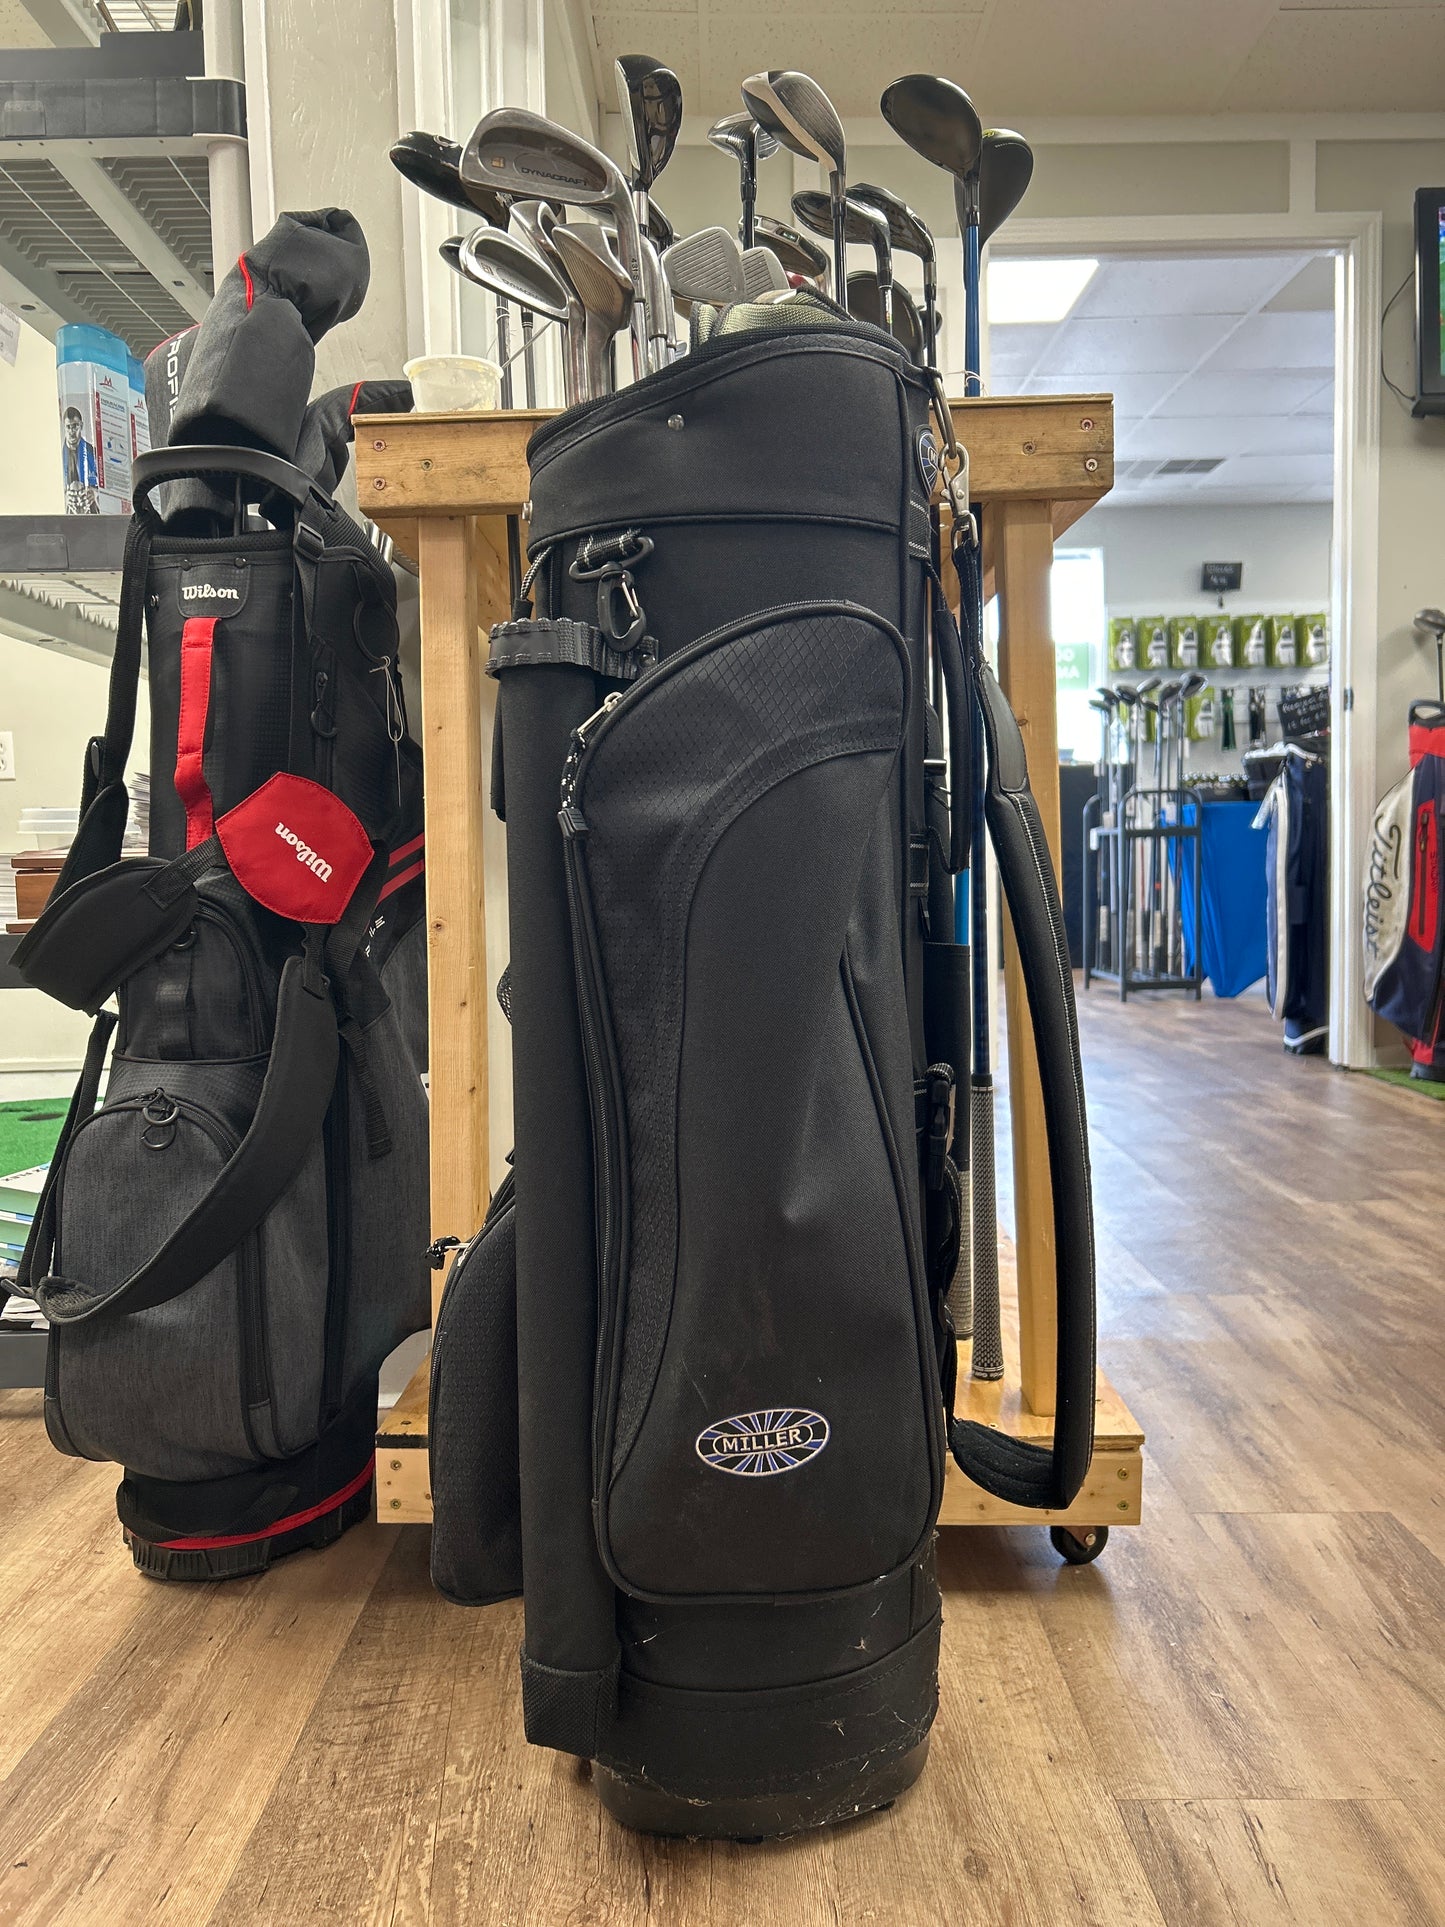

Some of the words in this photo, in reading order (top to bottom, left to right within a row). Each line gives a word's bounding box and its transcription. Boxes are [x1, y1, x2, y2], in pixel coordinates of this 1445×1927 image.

[521, 167, 588, 187] DYNACRAFT
[181, 584, 240, 600] Wilson
[274, 821, 334, 884] Wilson
[1365, 814, 1402, 960] Titleist
[722, 1428, 802, 1453] MILLER
